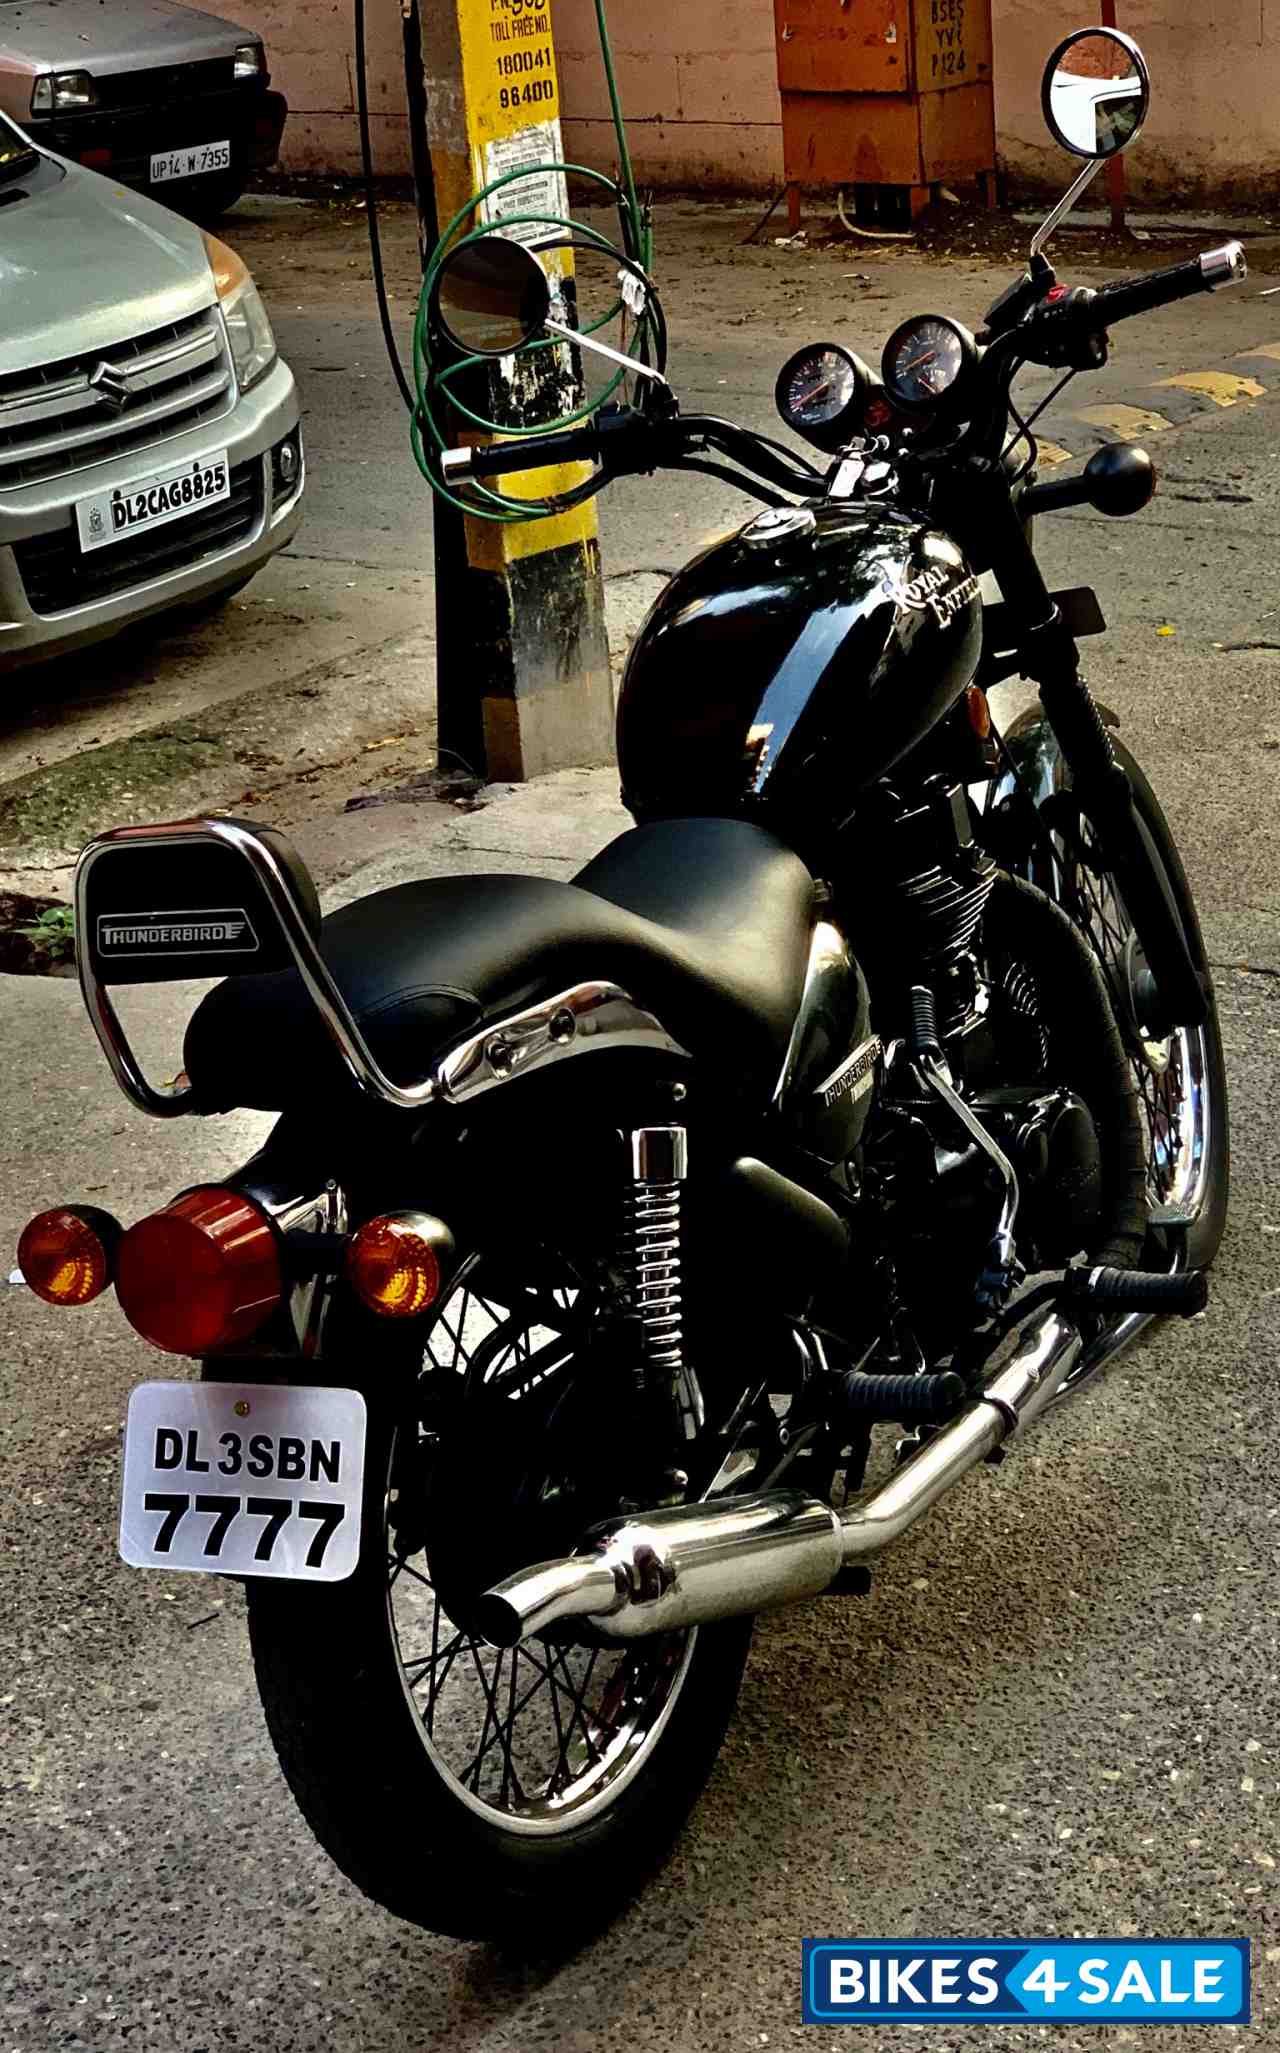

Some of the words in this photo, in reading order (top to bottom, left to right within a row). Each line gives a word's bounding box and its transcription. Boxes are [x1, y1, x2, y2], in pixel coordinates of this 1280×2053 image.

[512, 15, 534, 38] FREE
[497, 47, 551, 76] 180041
[500, 79, 553, 108] 96400
[113, 465, 225, 529] DL2CAG8825
[926, 574, 981, 629] ENFIEL
[101, 922, 245, 945] THUNDERBIRD
[144, 1493, 345, 1568] 7777
